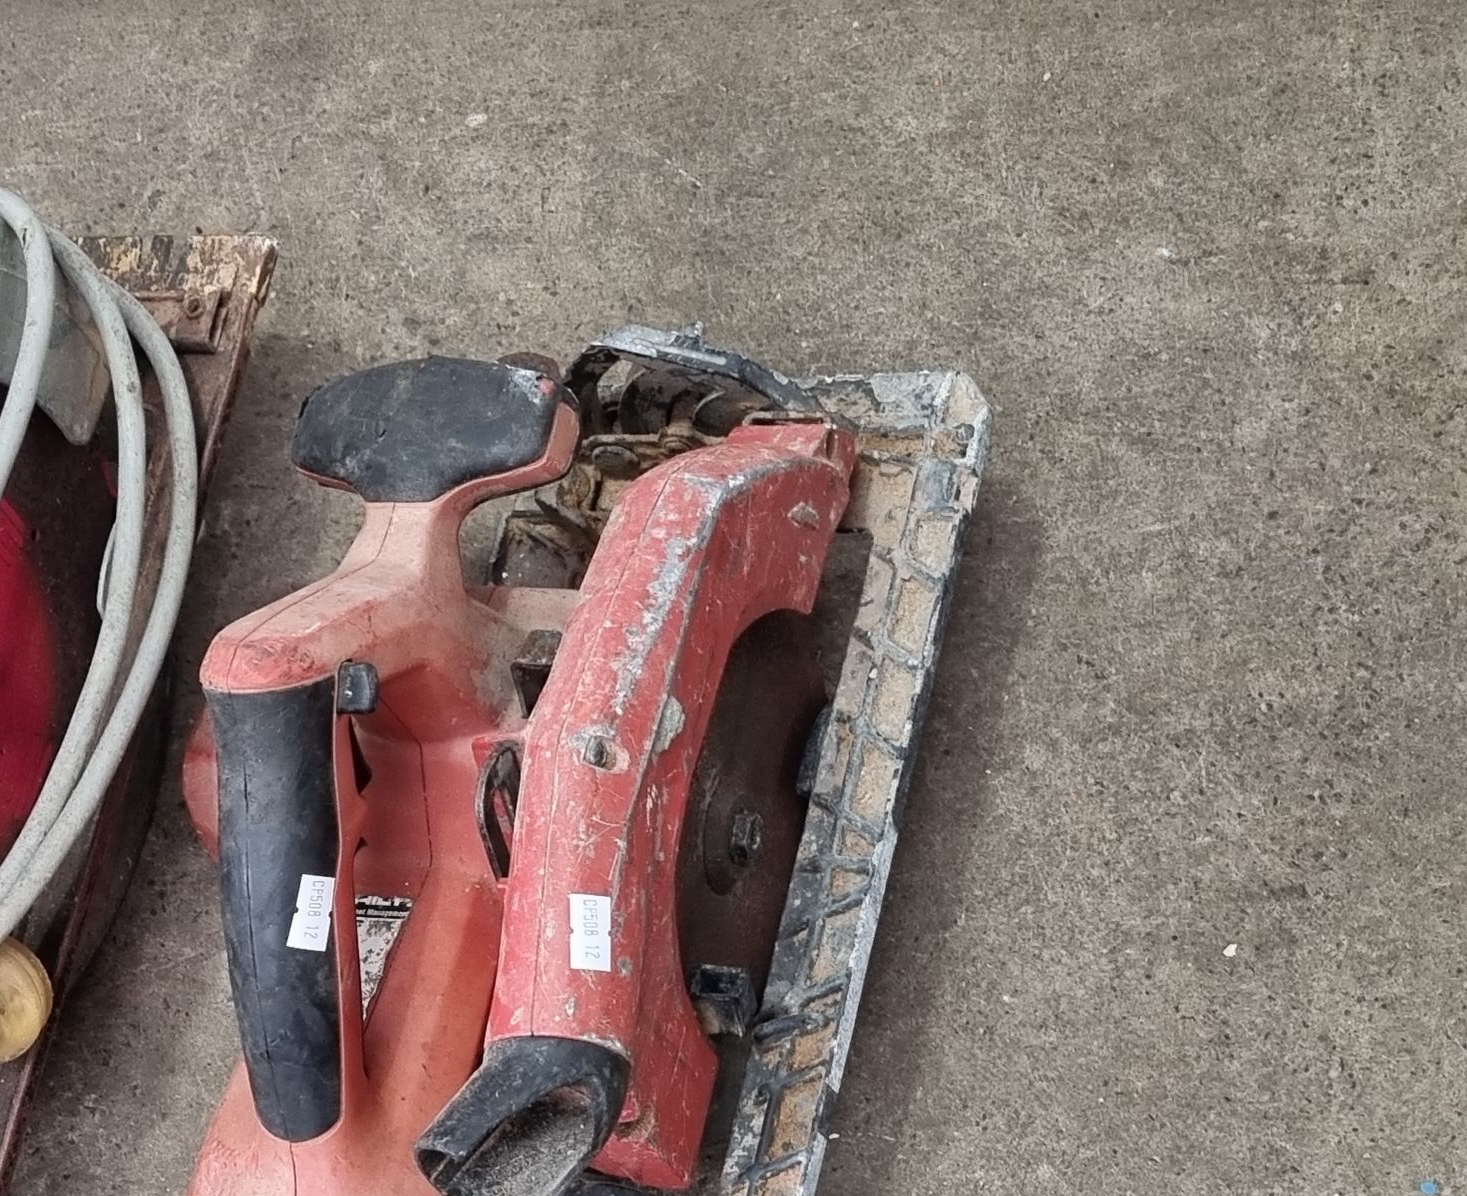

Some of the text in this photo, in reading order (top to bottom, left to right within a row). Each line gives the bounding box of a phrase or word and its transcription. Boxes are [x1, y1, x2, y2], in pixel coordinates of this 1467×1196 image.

[303, 880, 325, 940] CP508 12
[366, 908, 409, 918] Managemen
[582, 899, 601, 959] CP508 12
